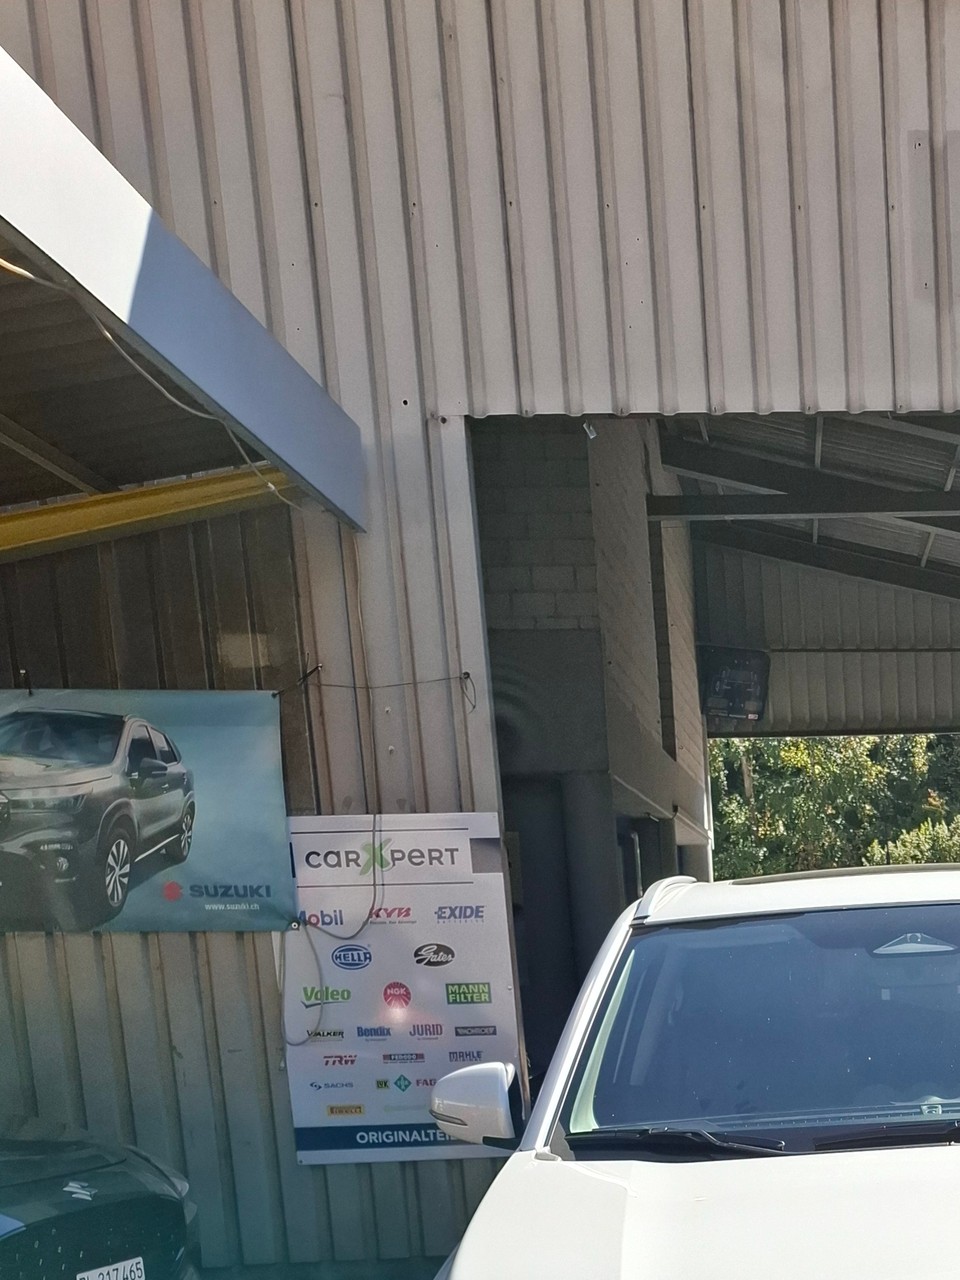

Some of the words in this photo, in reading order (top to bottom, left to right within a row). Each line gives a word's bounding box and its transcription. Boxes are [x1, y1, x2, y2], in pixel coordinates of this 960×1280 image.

[189, 884, 272, 898] SUZUKI
[435, 905, 485, 919] EXIDE
[334, 950, 373, 965] HELLA
[416, 945, 454, 966] Gates
[386, 987, 407, 996] NGK
[447, 984, 489, 994] MANN
[449, 993, 490, 1003] FILTER
[307, 1030, 345, 1039] WALKER
[357, 1026, 391, 1037] Bendix
[409, 1024, 443, 1036] JURID
[323, 1054, 357, 1066] TRW
[323, 1081, 354, 1089] SACHS
